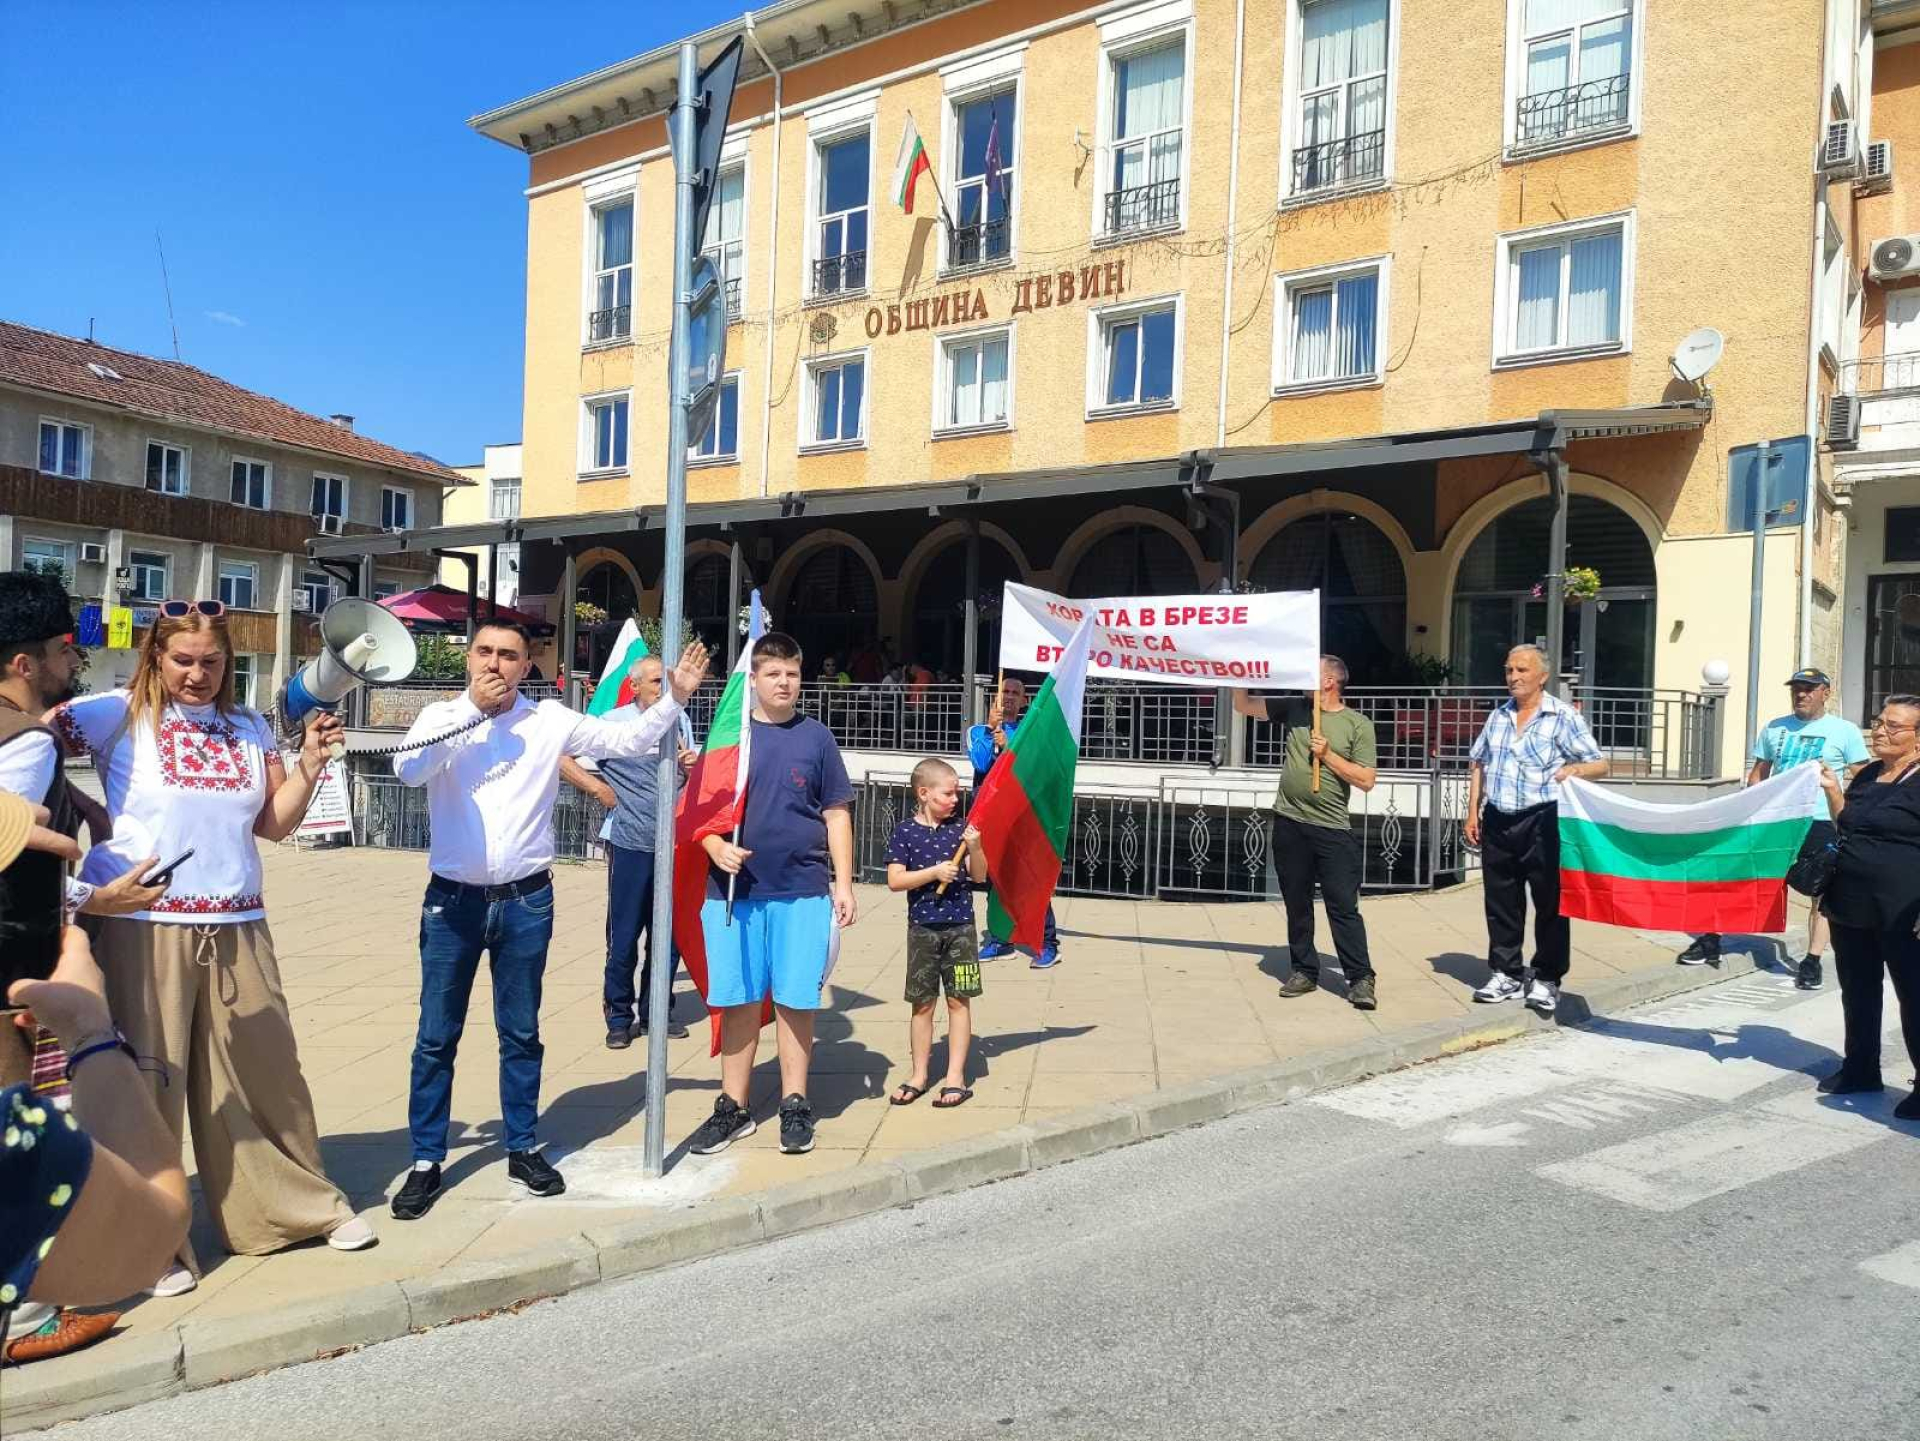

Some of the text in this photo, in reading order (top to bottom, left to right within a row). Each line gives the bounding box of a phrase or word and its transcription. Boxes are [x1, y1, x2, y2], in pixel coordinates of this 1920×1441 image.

[865, 259, 1125, 339] ОБЩИНА ДЕВИН
[1046, 601, 1248, 626] ХОРТА В БРЕЗЕ
[1106, 632, 1177, 652] НЕ СА
[1036, 645, 1270, 679] ВТРО КАЧЕСТВО!!!
